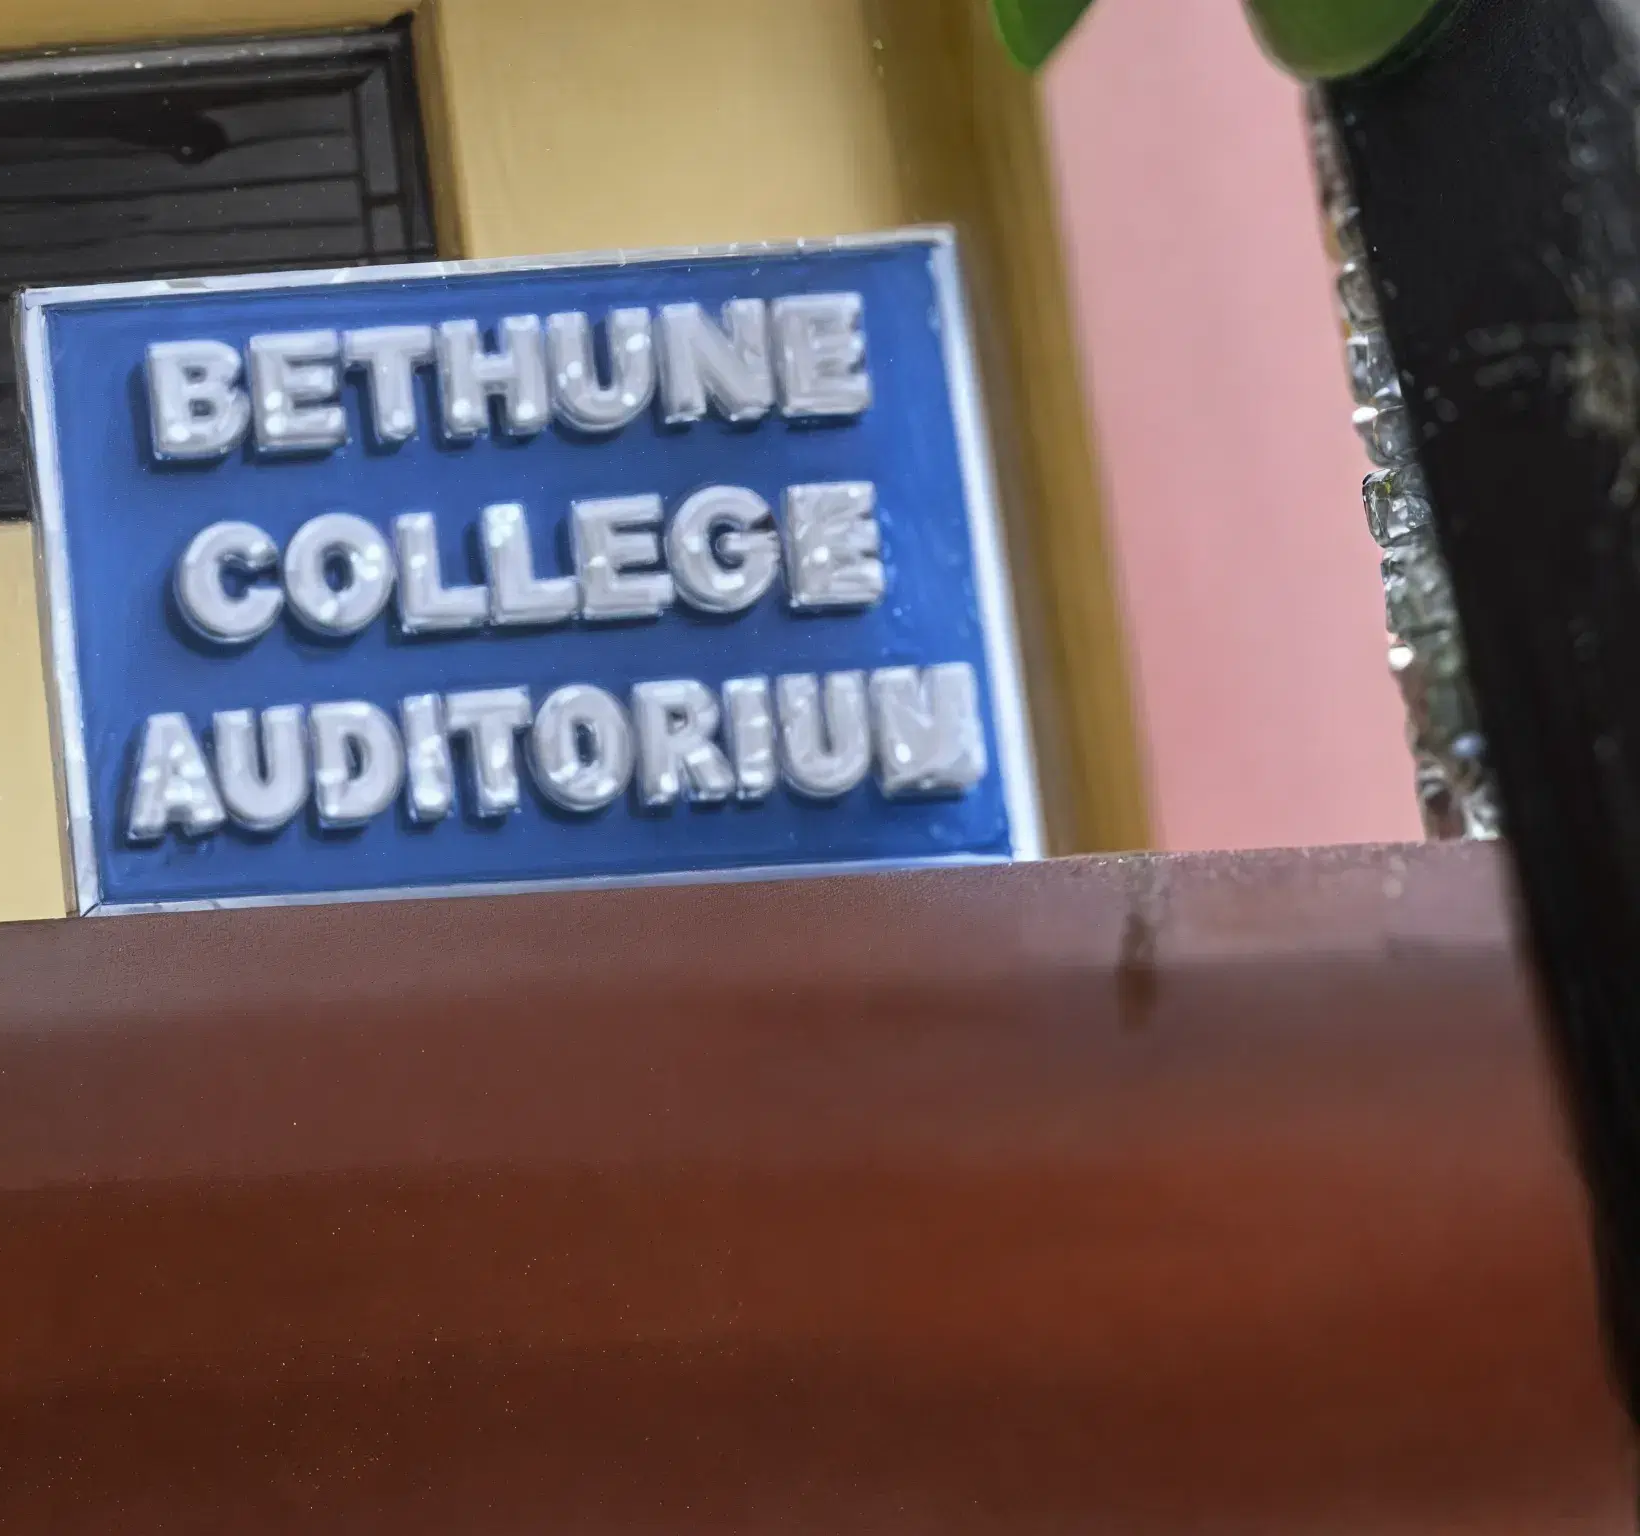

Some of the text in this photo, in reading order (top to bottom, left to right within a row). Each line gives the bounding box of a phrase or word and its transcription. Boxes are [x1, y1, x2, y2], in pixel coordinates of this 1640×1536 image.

[145, 292, 872, 460] BETHUNE
[176, 480, 886, 645] COLLEGE
[126, 661, 987, 842] AUDITORIUM
